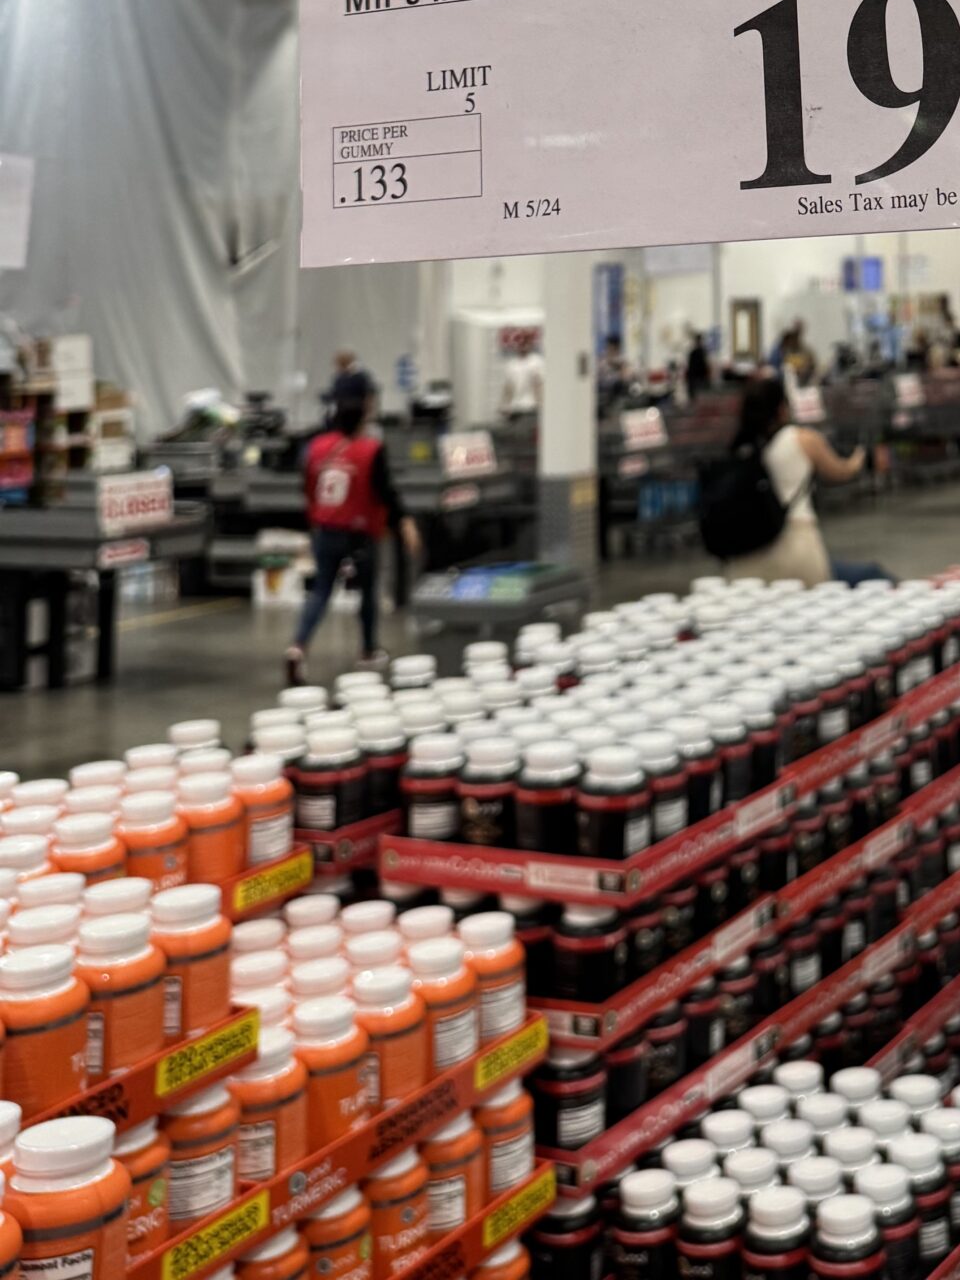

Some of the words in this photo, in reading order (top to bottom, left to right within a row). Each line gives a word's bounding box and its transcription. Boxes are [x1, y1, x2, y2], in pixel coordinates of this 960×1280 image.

[426, 64, 493, 92] LIMIT
[463, 91, 477, 114] 5
[340, 127, 379, 144] PRICE
[382, 123, 410, 141] PER
[340, 142, 392, 160] GUMMY
[340, 162, 408, 204] .133
[502, 200, 520, 220] M
[525, 197, 562, 218] 5/24
[797, 195, 843, 216] Sales
[848, 192, 884, 212] Tax
[890, 193, 929, 213] may
[935, 187, 958, 206] be
